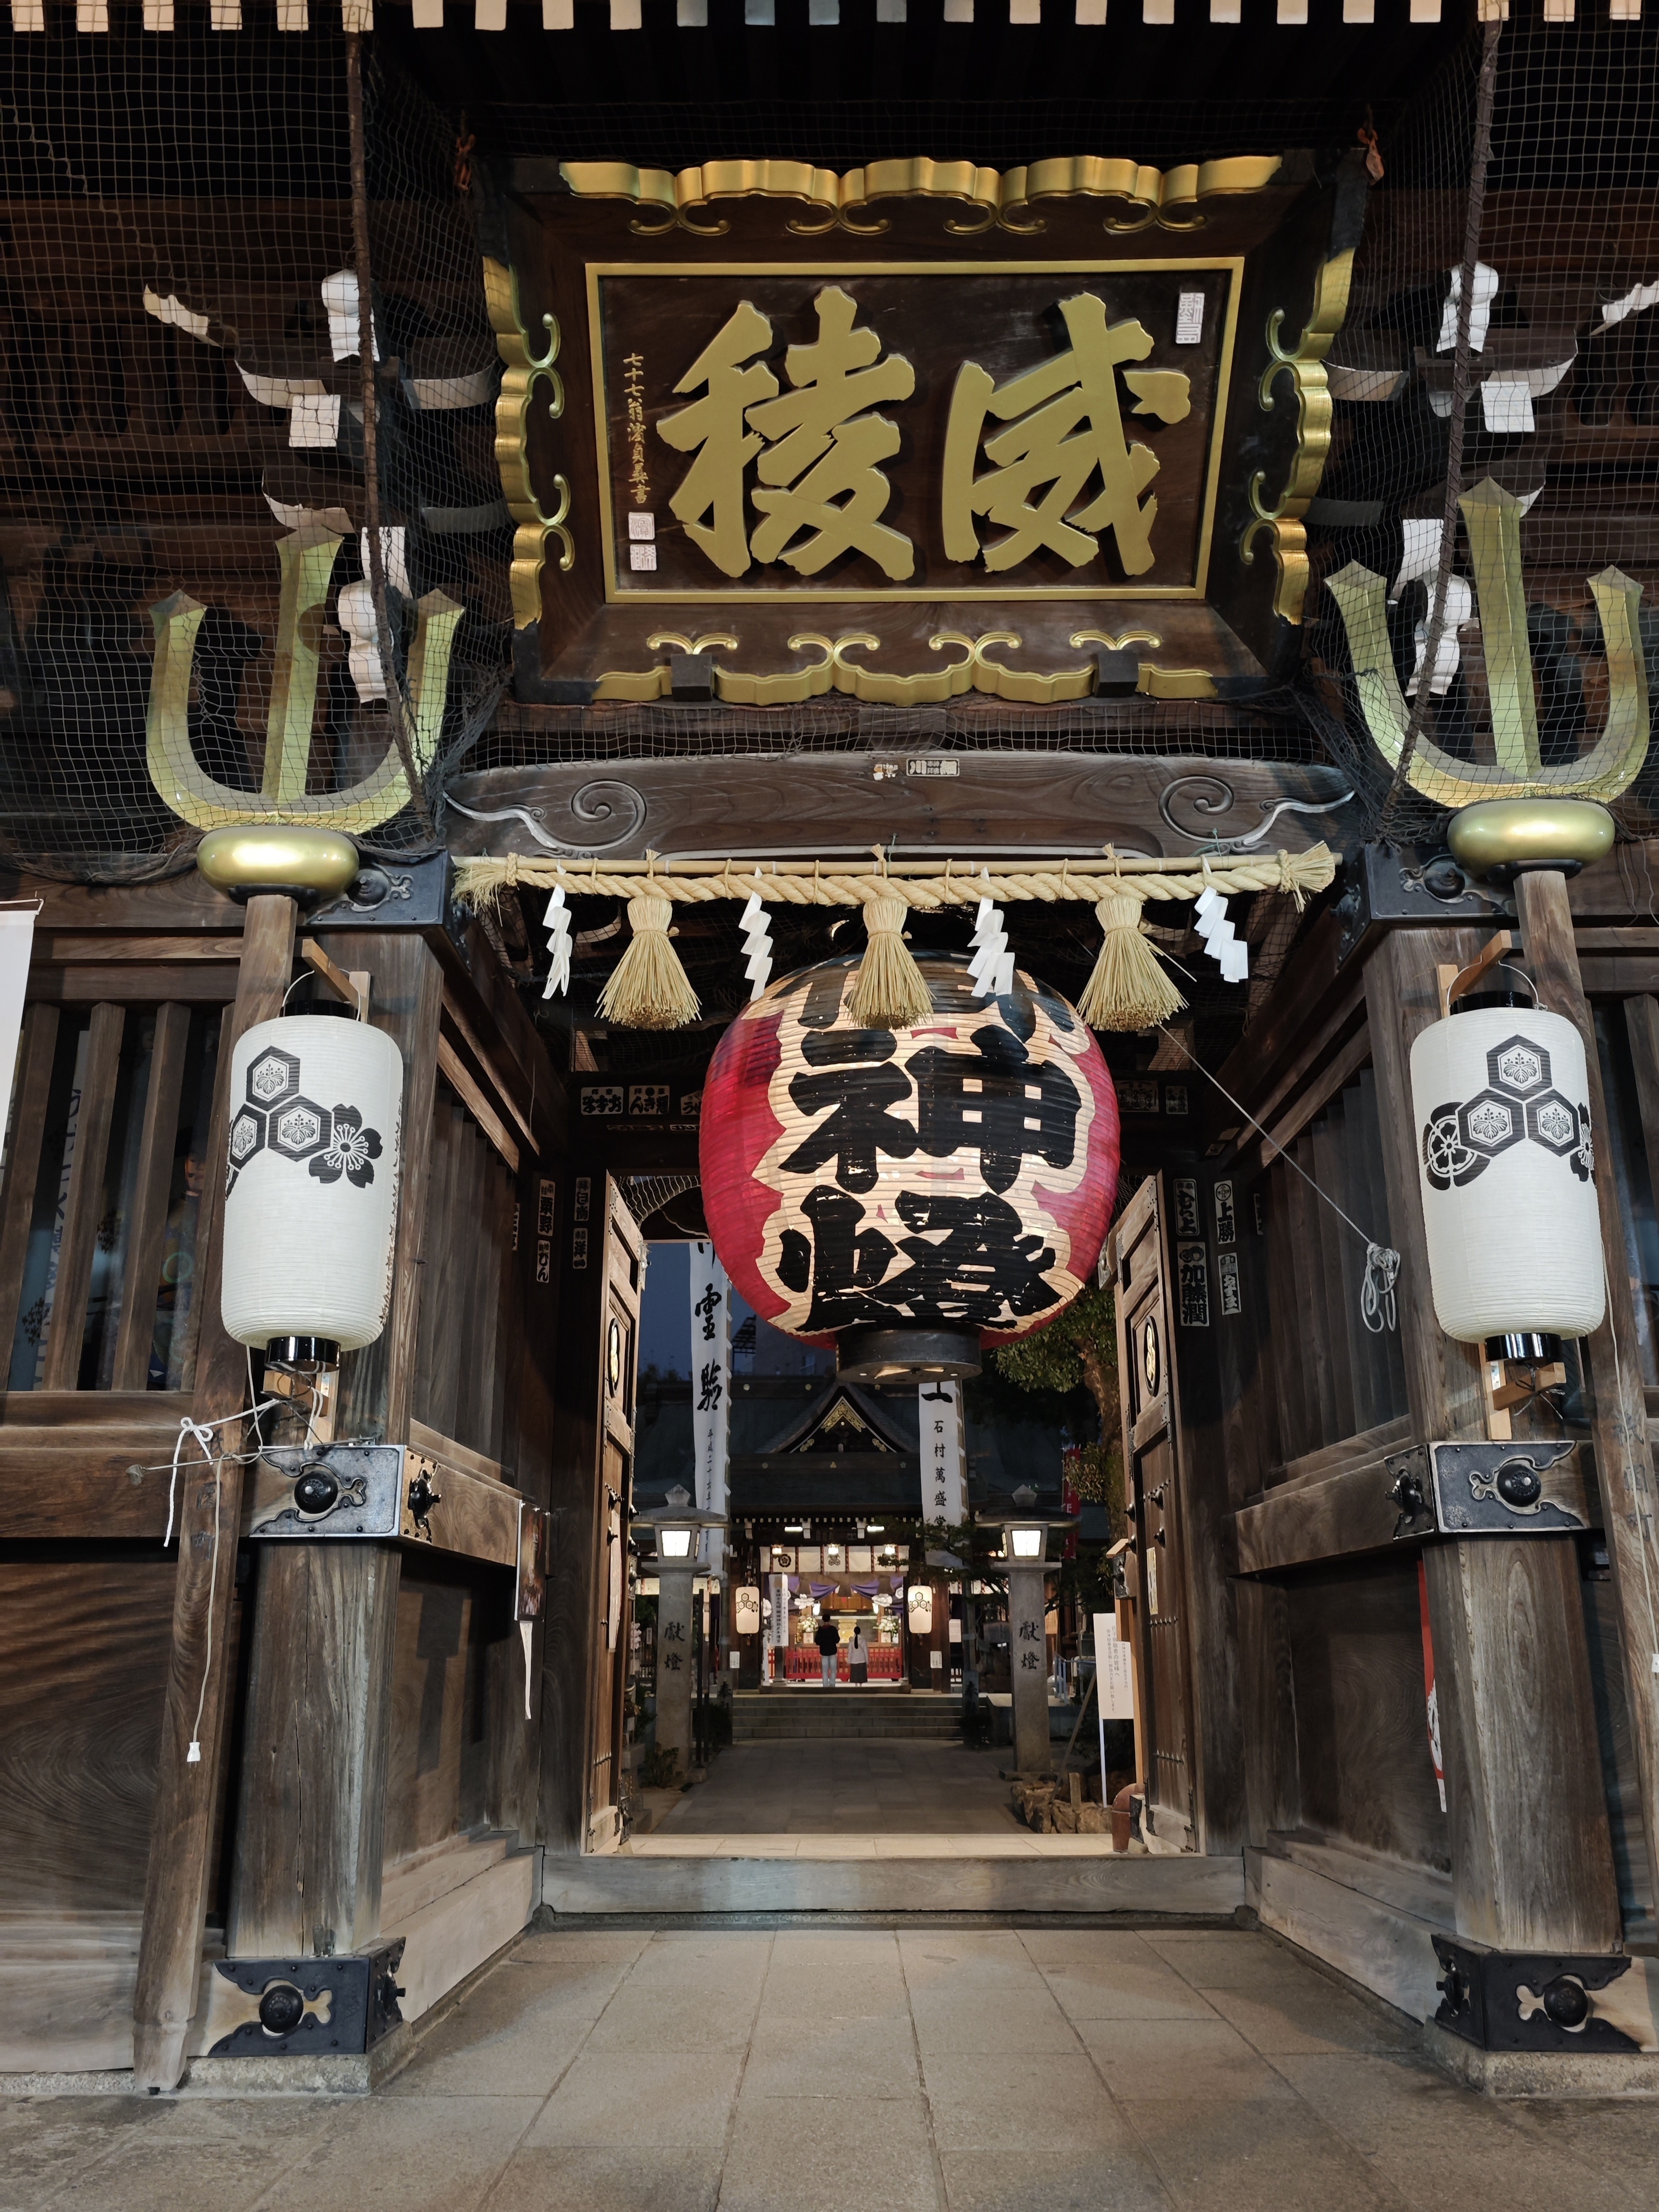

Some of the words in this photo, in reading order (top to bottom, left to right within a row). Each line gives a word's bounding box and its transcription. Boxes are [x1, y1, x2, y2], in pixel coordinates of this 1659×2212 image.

[934, 1420, 947, 1527] 石村萬盛堂
